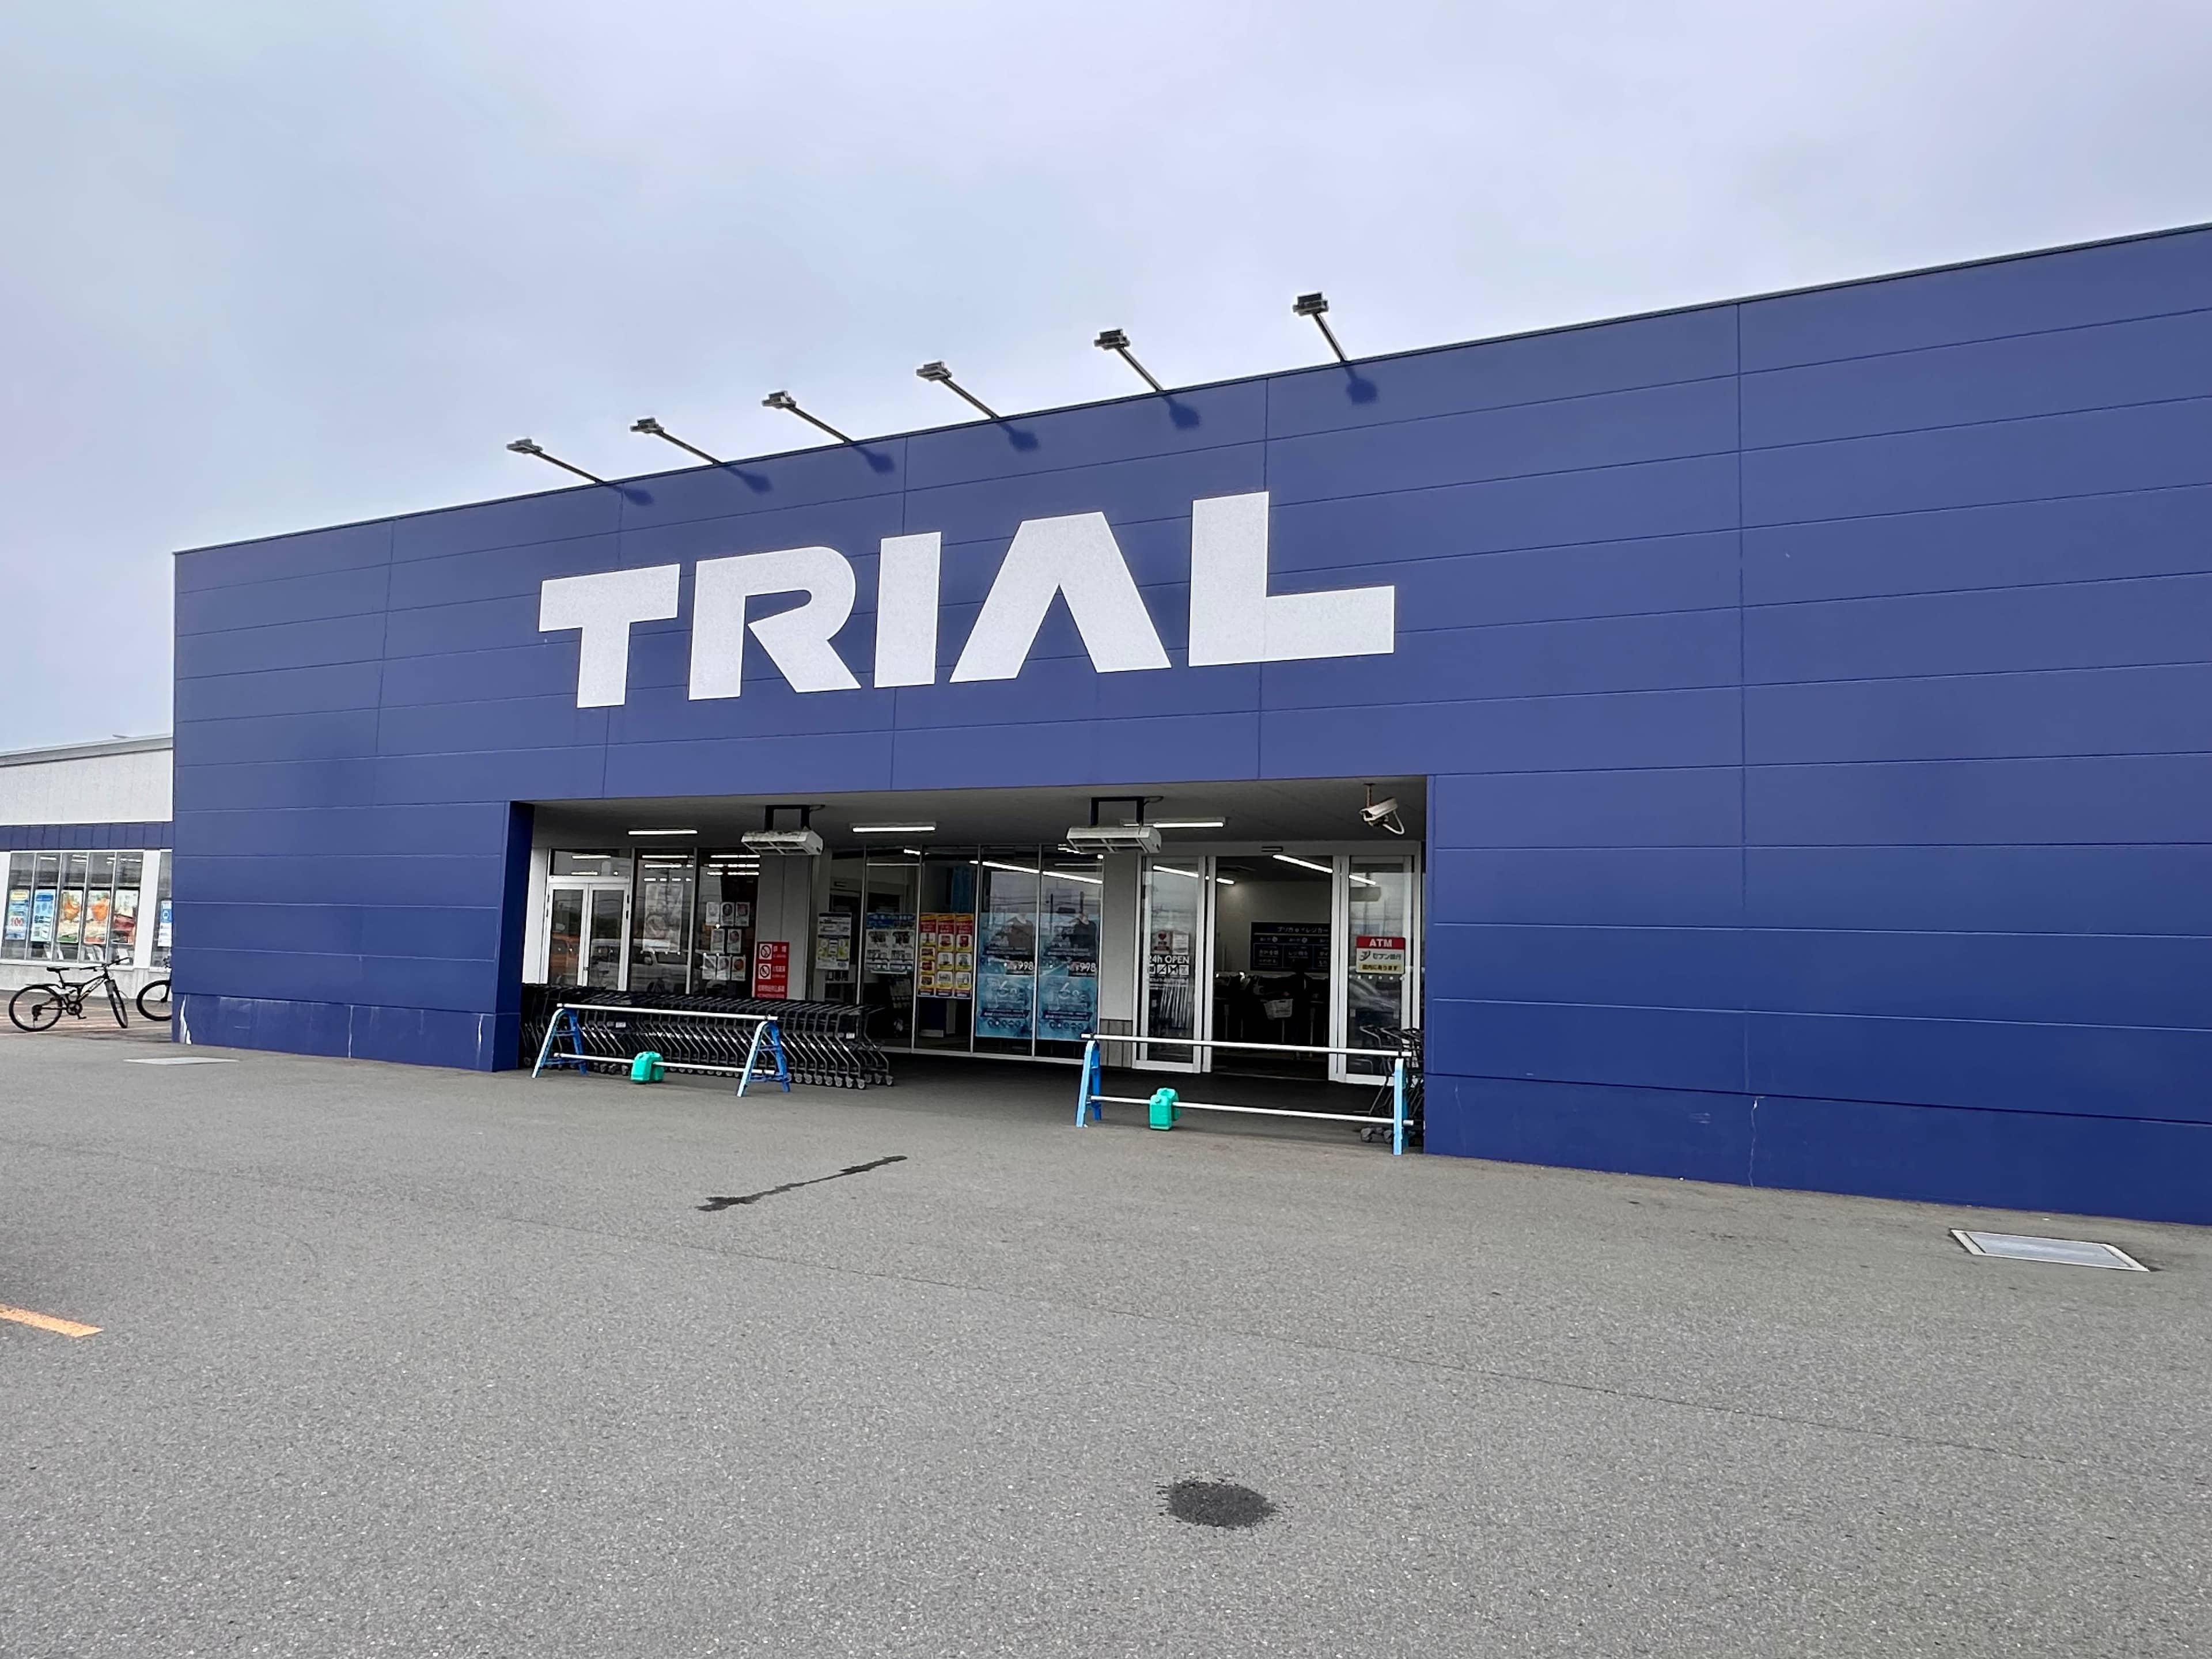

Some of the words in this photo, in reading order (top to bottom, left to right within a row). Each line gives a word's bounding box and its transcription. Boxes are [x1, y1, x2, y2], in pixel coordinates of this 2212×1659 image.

[539, 491, 1395, 709] TRIAL
[1369, 938, 1392, 948] ATM
[1165, 955, 1190, 964] OPEN
